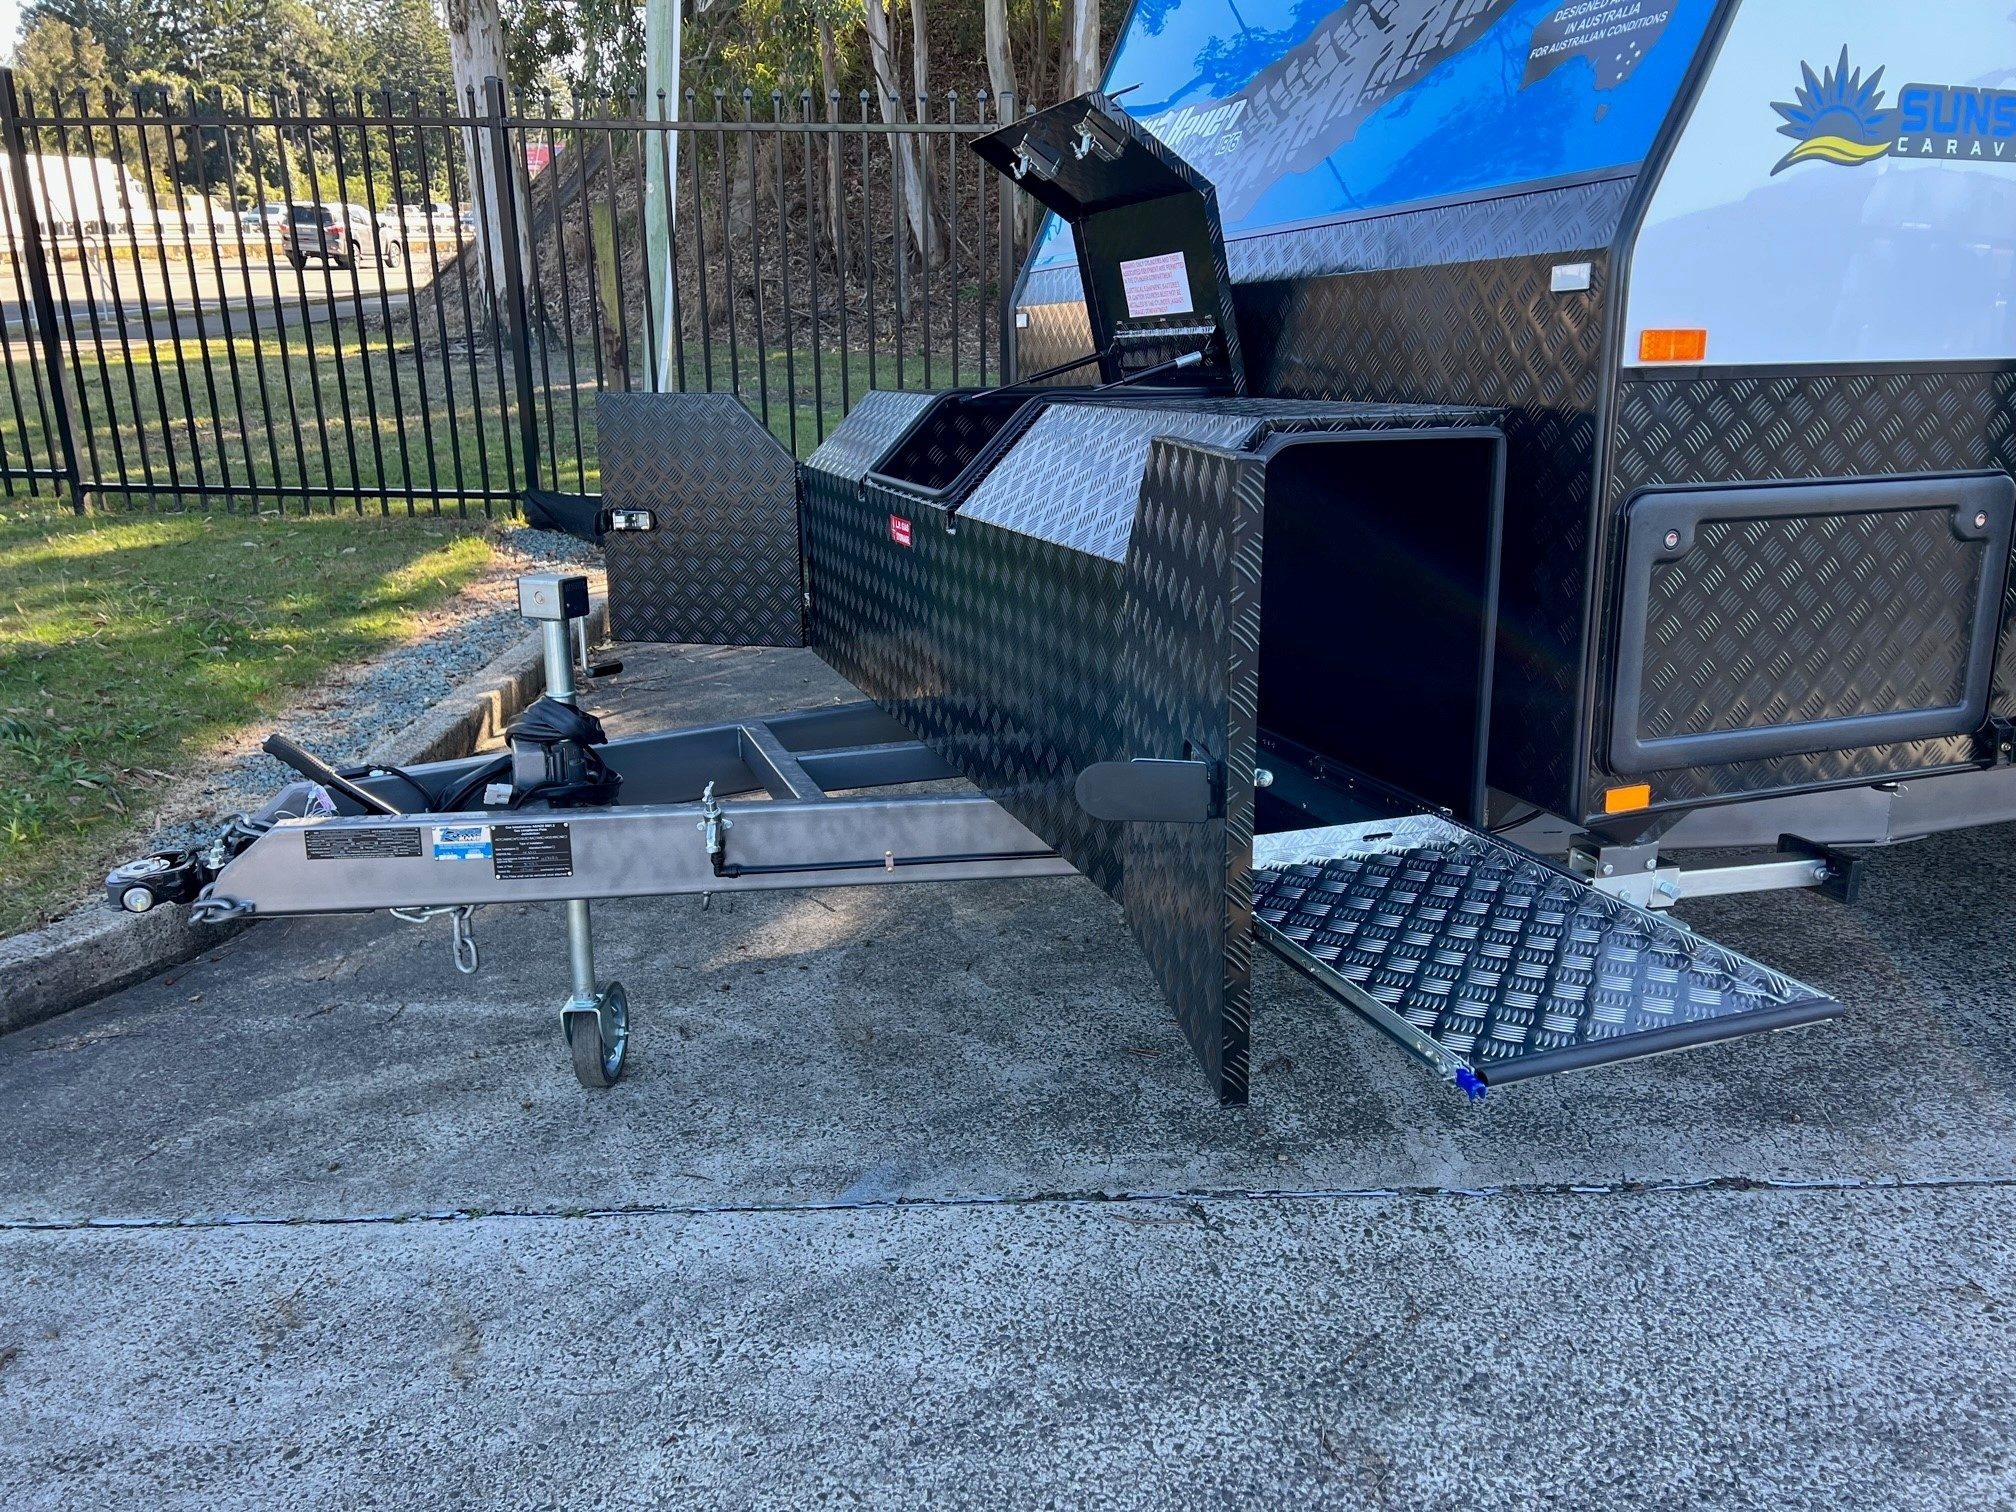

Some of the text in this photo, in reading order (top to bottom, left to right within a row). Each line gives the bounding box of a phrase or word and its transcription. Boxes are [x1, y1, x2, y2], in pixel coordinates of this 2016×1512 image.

[1554, 0, 1609, 22] DESIGNED
[1565, 2, 1641, 35] IN AUSTRALIA
[1530, 10, 1669, 59] FOR AUSTRALIAN CONDITIONS
[1901, 90, 2016, 138] SUNS
[1897, 136, 2016, 157] CARAV
